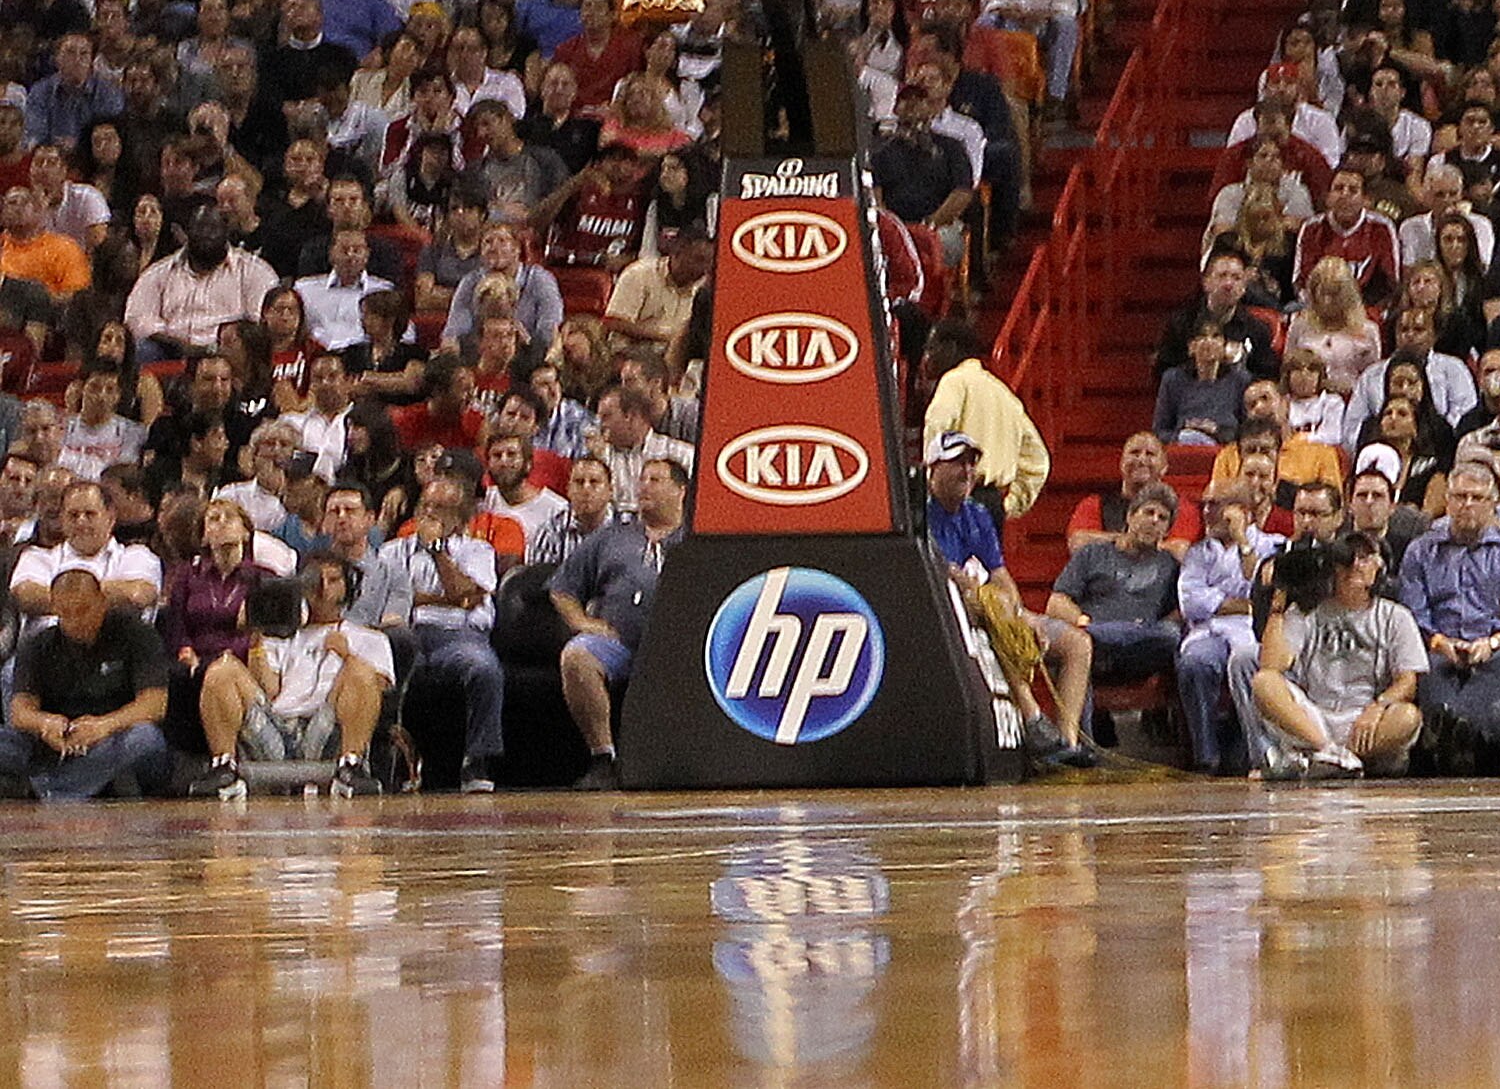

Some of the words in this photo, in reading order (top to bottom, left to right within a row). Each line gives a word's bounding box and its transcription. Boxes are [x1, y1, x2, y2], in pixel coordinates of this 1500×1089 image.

[740, 172, 839, 200] SPALDING
[577, 213, 634, 237] MIAMI
[753, 225, 829, 258] KIA
[751, 329, 837, 367] KIA
[746, 443, 844, 486] KIA
[725, 566, 868, 745] hp
